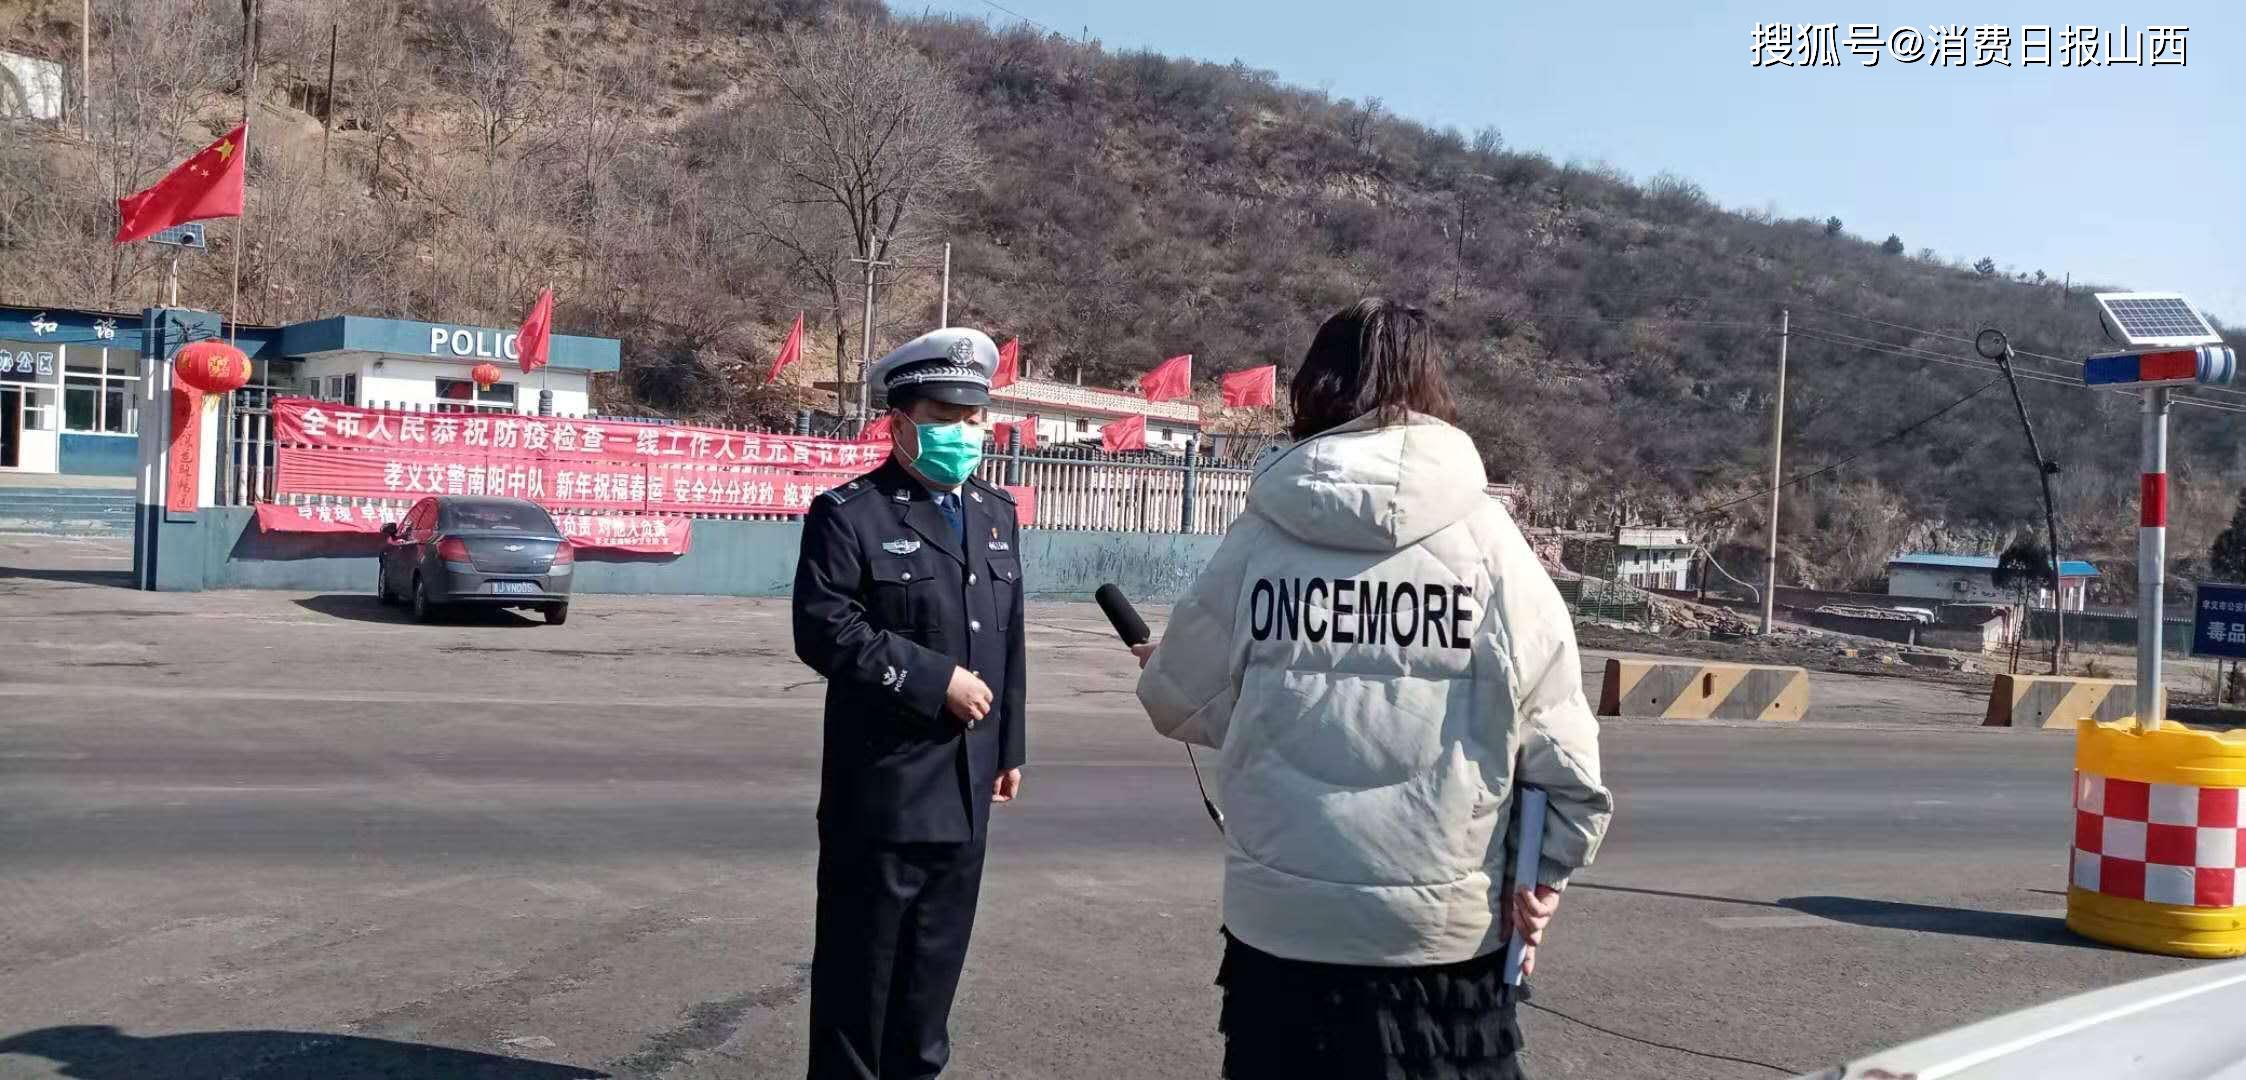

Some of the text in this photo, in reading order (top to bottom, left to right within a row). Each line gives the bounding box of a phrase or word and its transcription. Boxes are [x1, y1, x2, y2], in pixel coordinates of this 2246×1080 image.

[430, 327, 520, 360] POLIC
[384, 461, 545, 498] 孝义交警南阳中队
[556, 471, 664, 502] 新年祝福春运
[674, 479, 775, 506] 安全分分秒秒
[1251, 577, 1473, 649] ONCEMORE
[2207, 621, 2245, 642] 毒品
